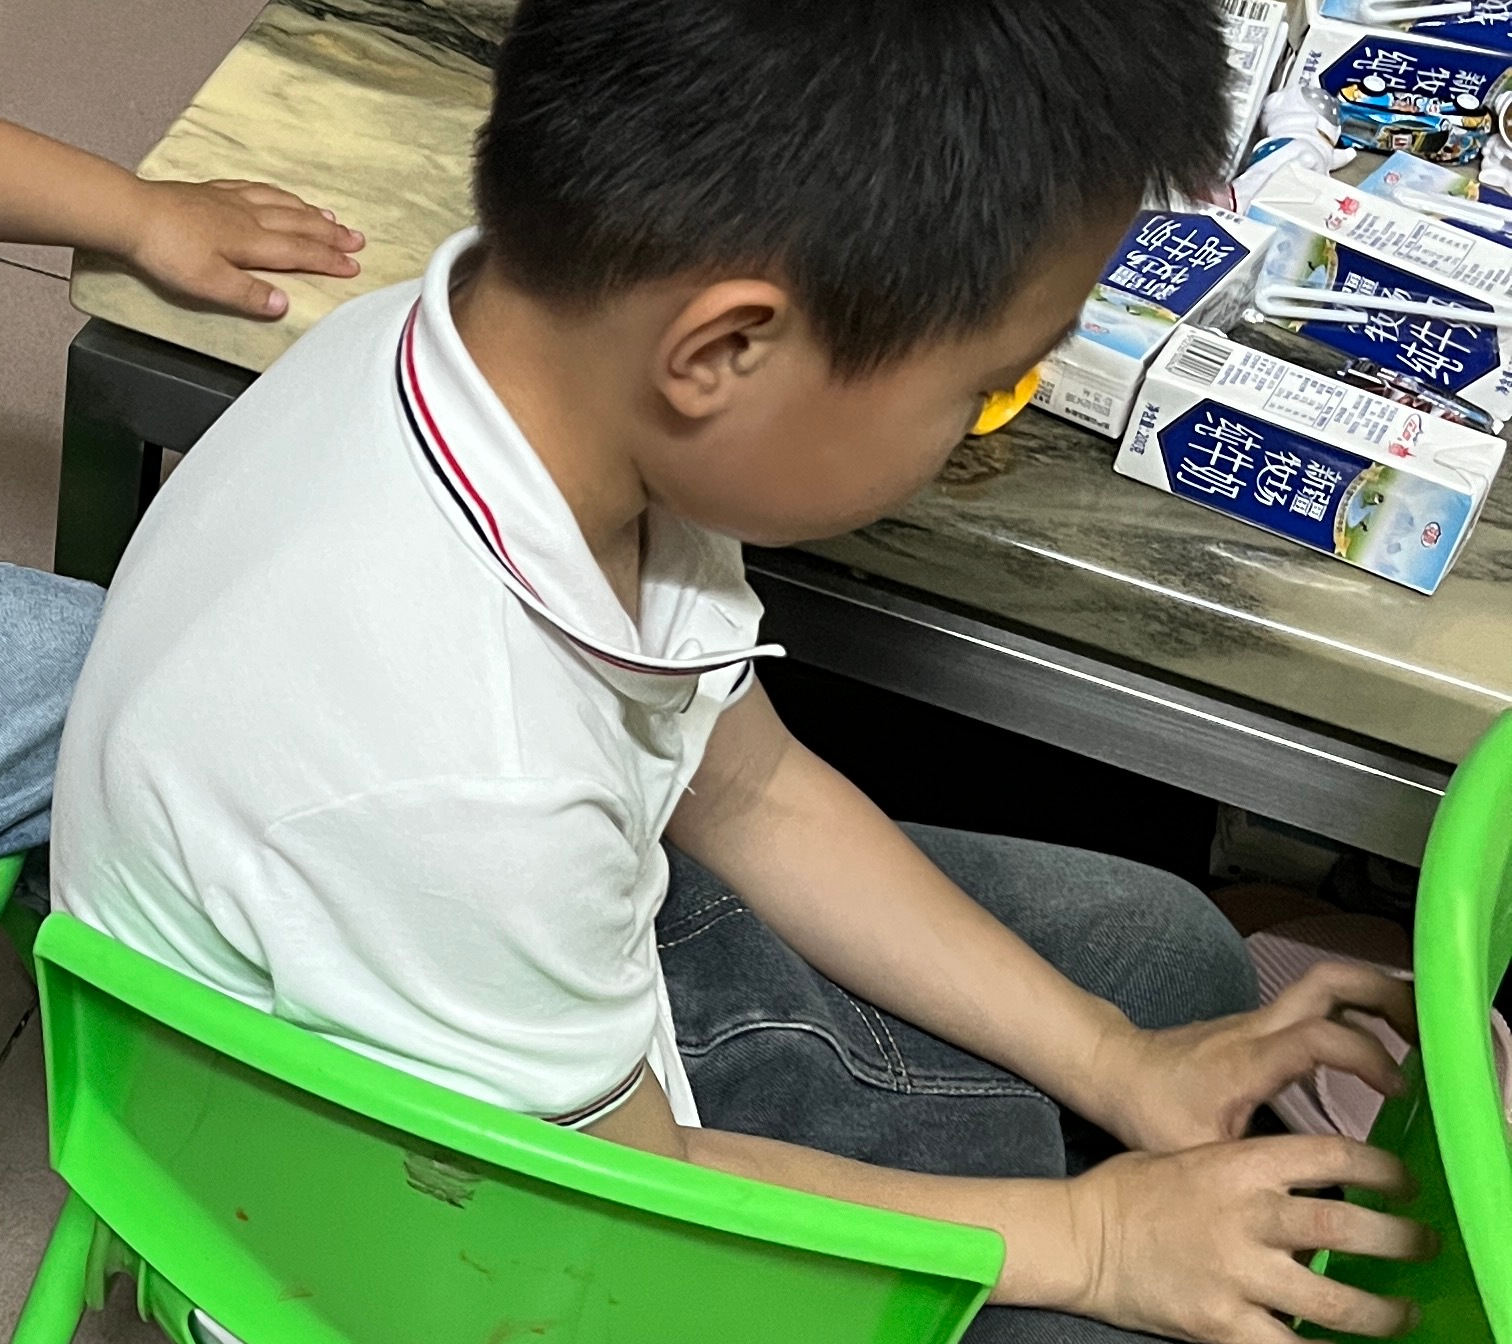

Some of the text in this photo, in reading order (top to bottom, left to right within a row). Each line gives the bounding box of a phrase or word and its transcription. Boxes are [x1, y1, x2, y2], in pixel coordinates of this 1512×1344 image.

[1413, 67, 1451, 96] 牧
[1126, 250, 1190, 285] 牧场
[1135, 214, 1235, 271] 纯牛奶
[1107, 263, 1182, 301] 新疆
[1176, 411, 1265, 500] 纯牛奶
[1253, 450, 1302, 506] 牧场
[1288, 458, 1343, 522] 新疆
